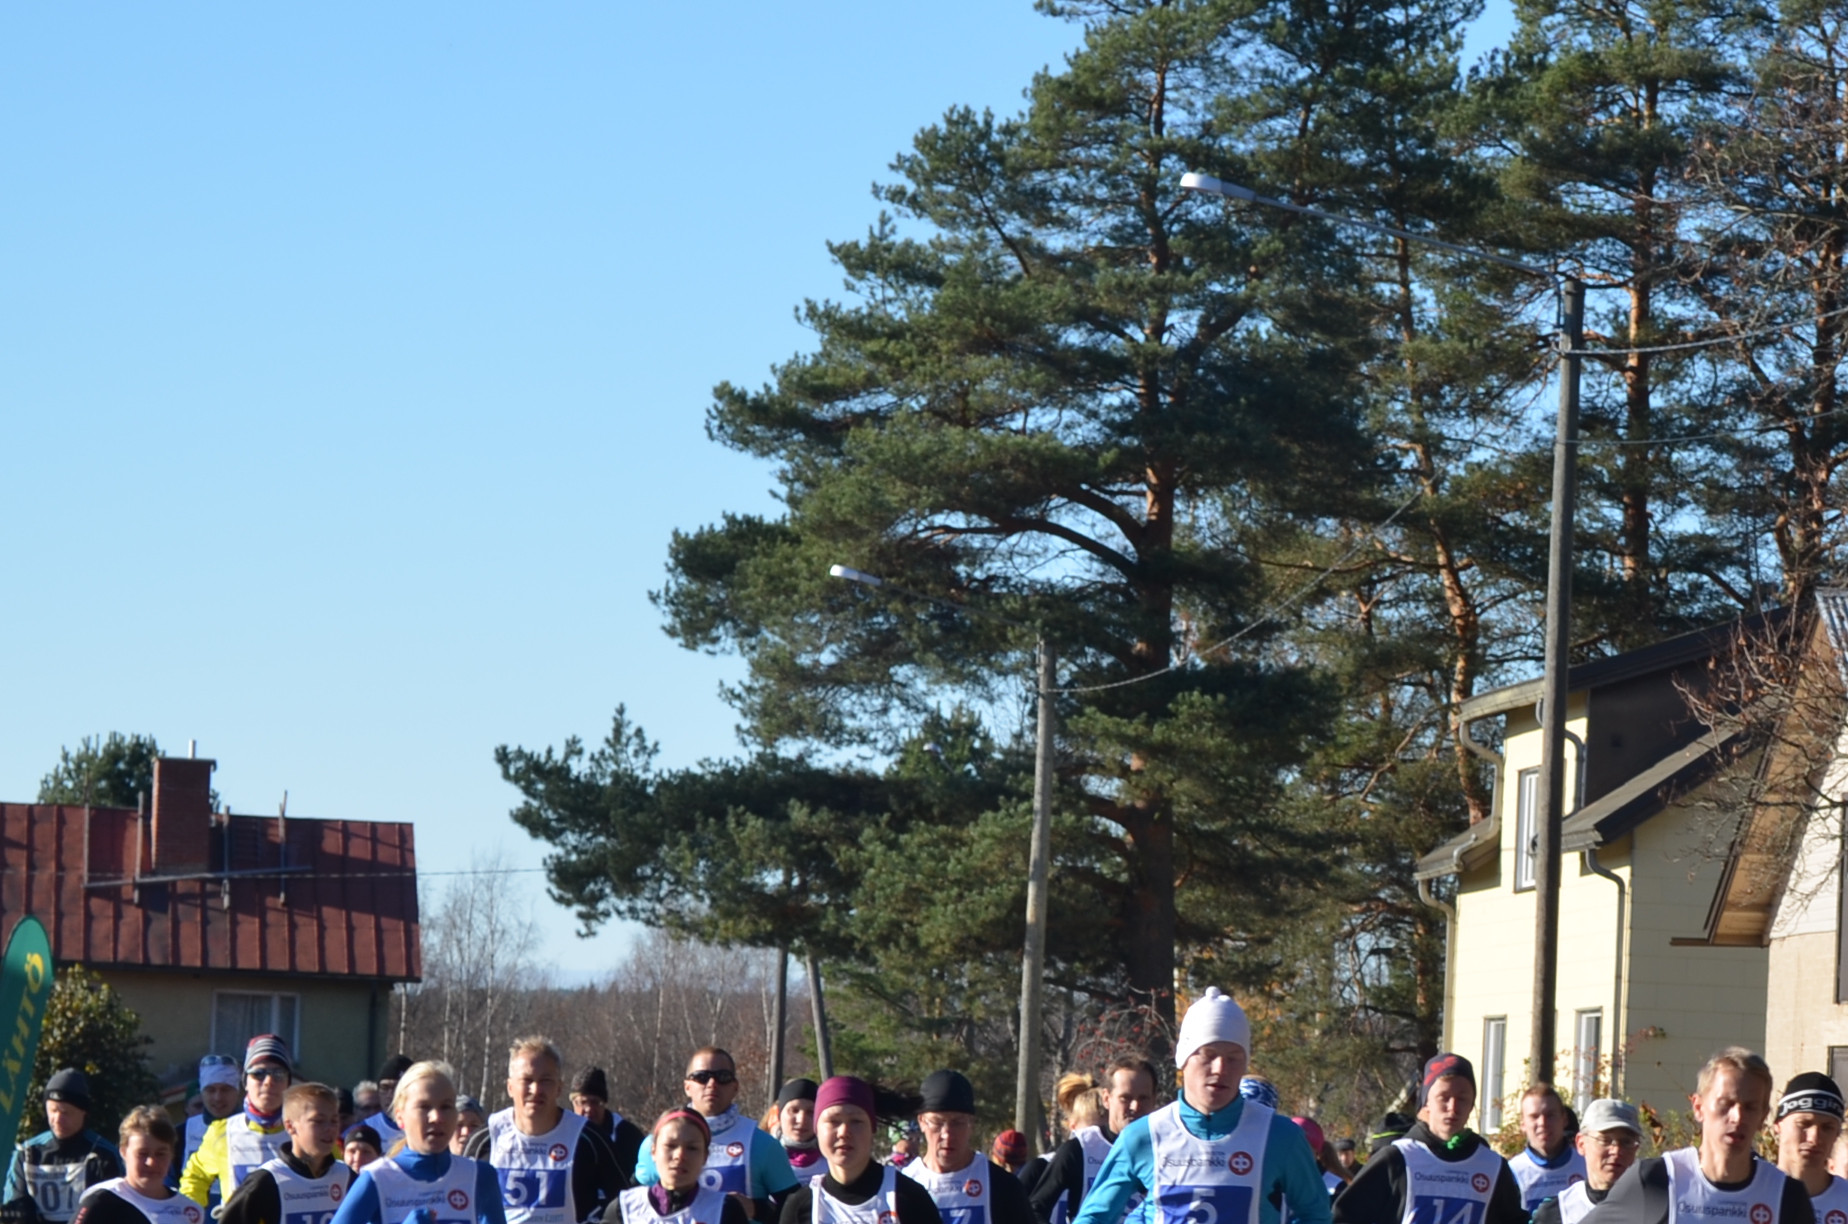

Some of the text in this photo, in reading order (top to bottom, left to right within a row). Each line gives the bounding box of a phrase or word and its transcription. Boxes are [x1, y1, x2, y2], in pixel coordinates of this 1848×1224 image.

[1414, 1172, 1469, 1184] Osuuspankki
[504, 1170, 548, 1206] 51
[1677, 1201, 1747, 1218] Osuuspankki
